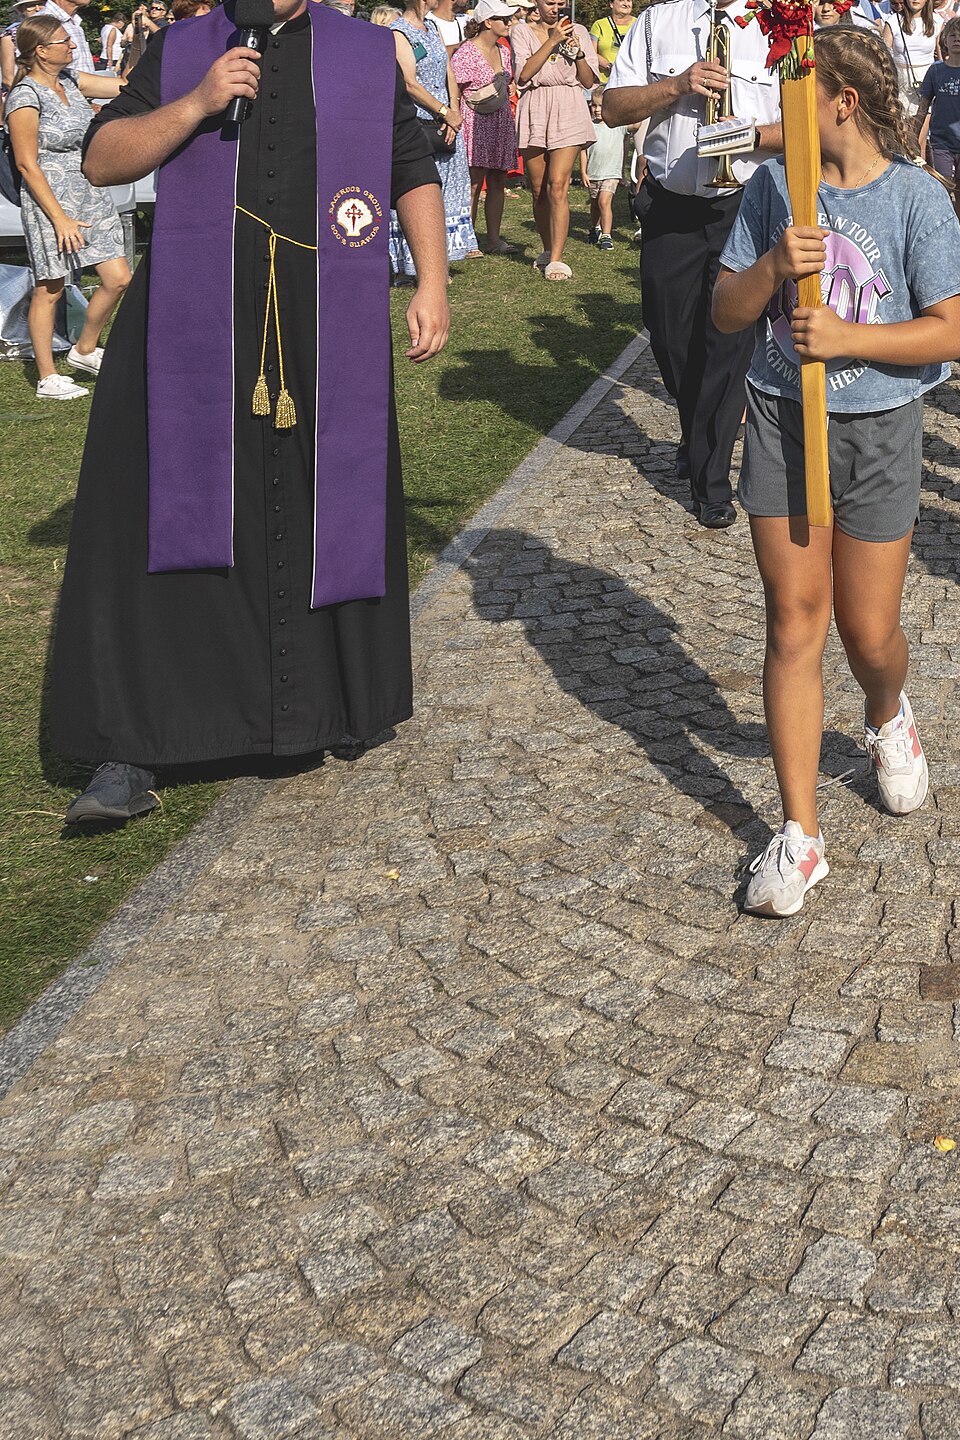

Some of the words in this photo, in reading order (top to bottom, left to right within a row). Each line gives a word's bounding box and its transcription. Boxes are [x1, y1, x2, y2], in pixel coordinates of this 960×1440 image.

[328, 186, 361, 214] SACERDOS
[363, 190, 383, 217] GROUP
[349, 226, 380, 247] GUARDS
[849, 222, 882, 263] TOUR
